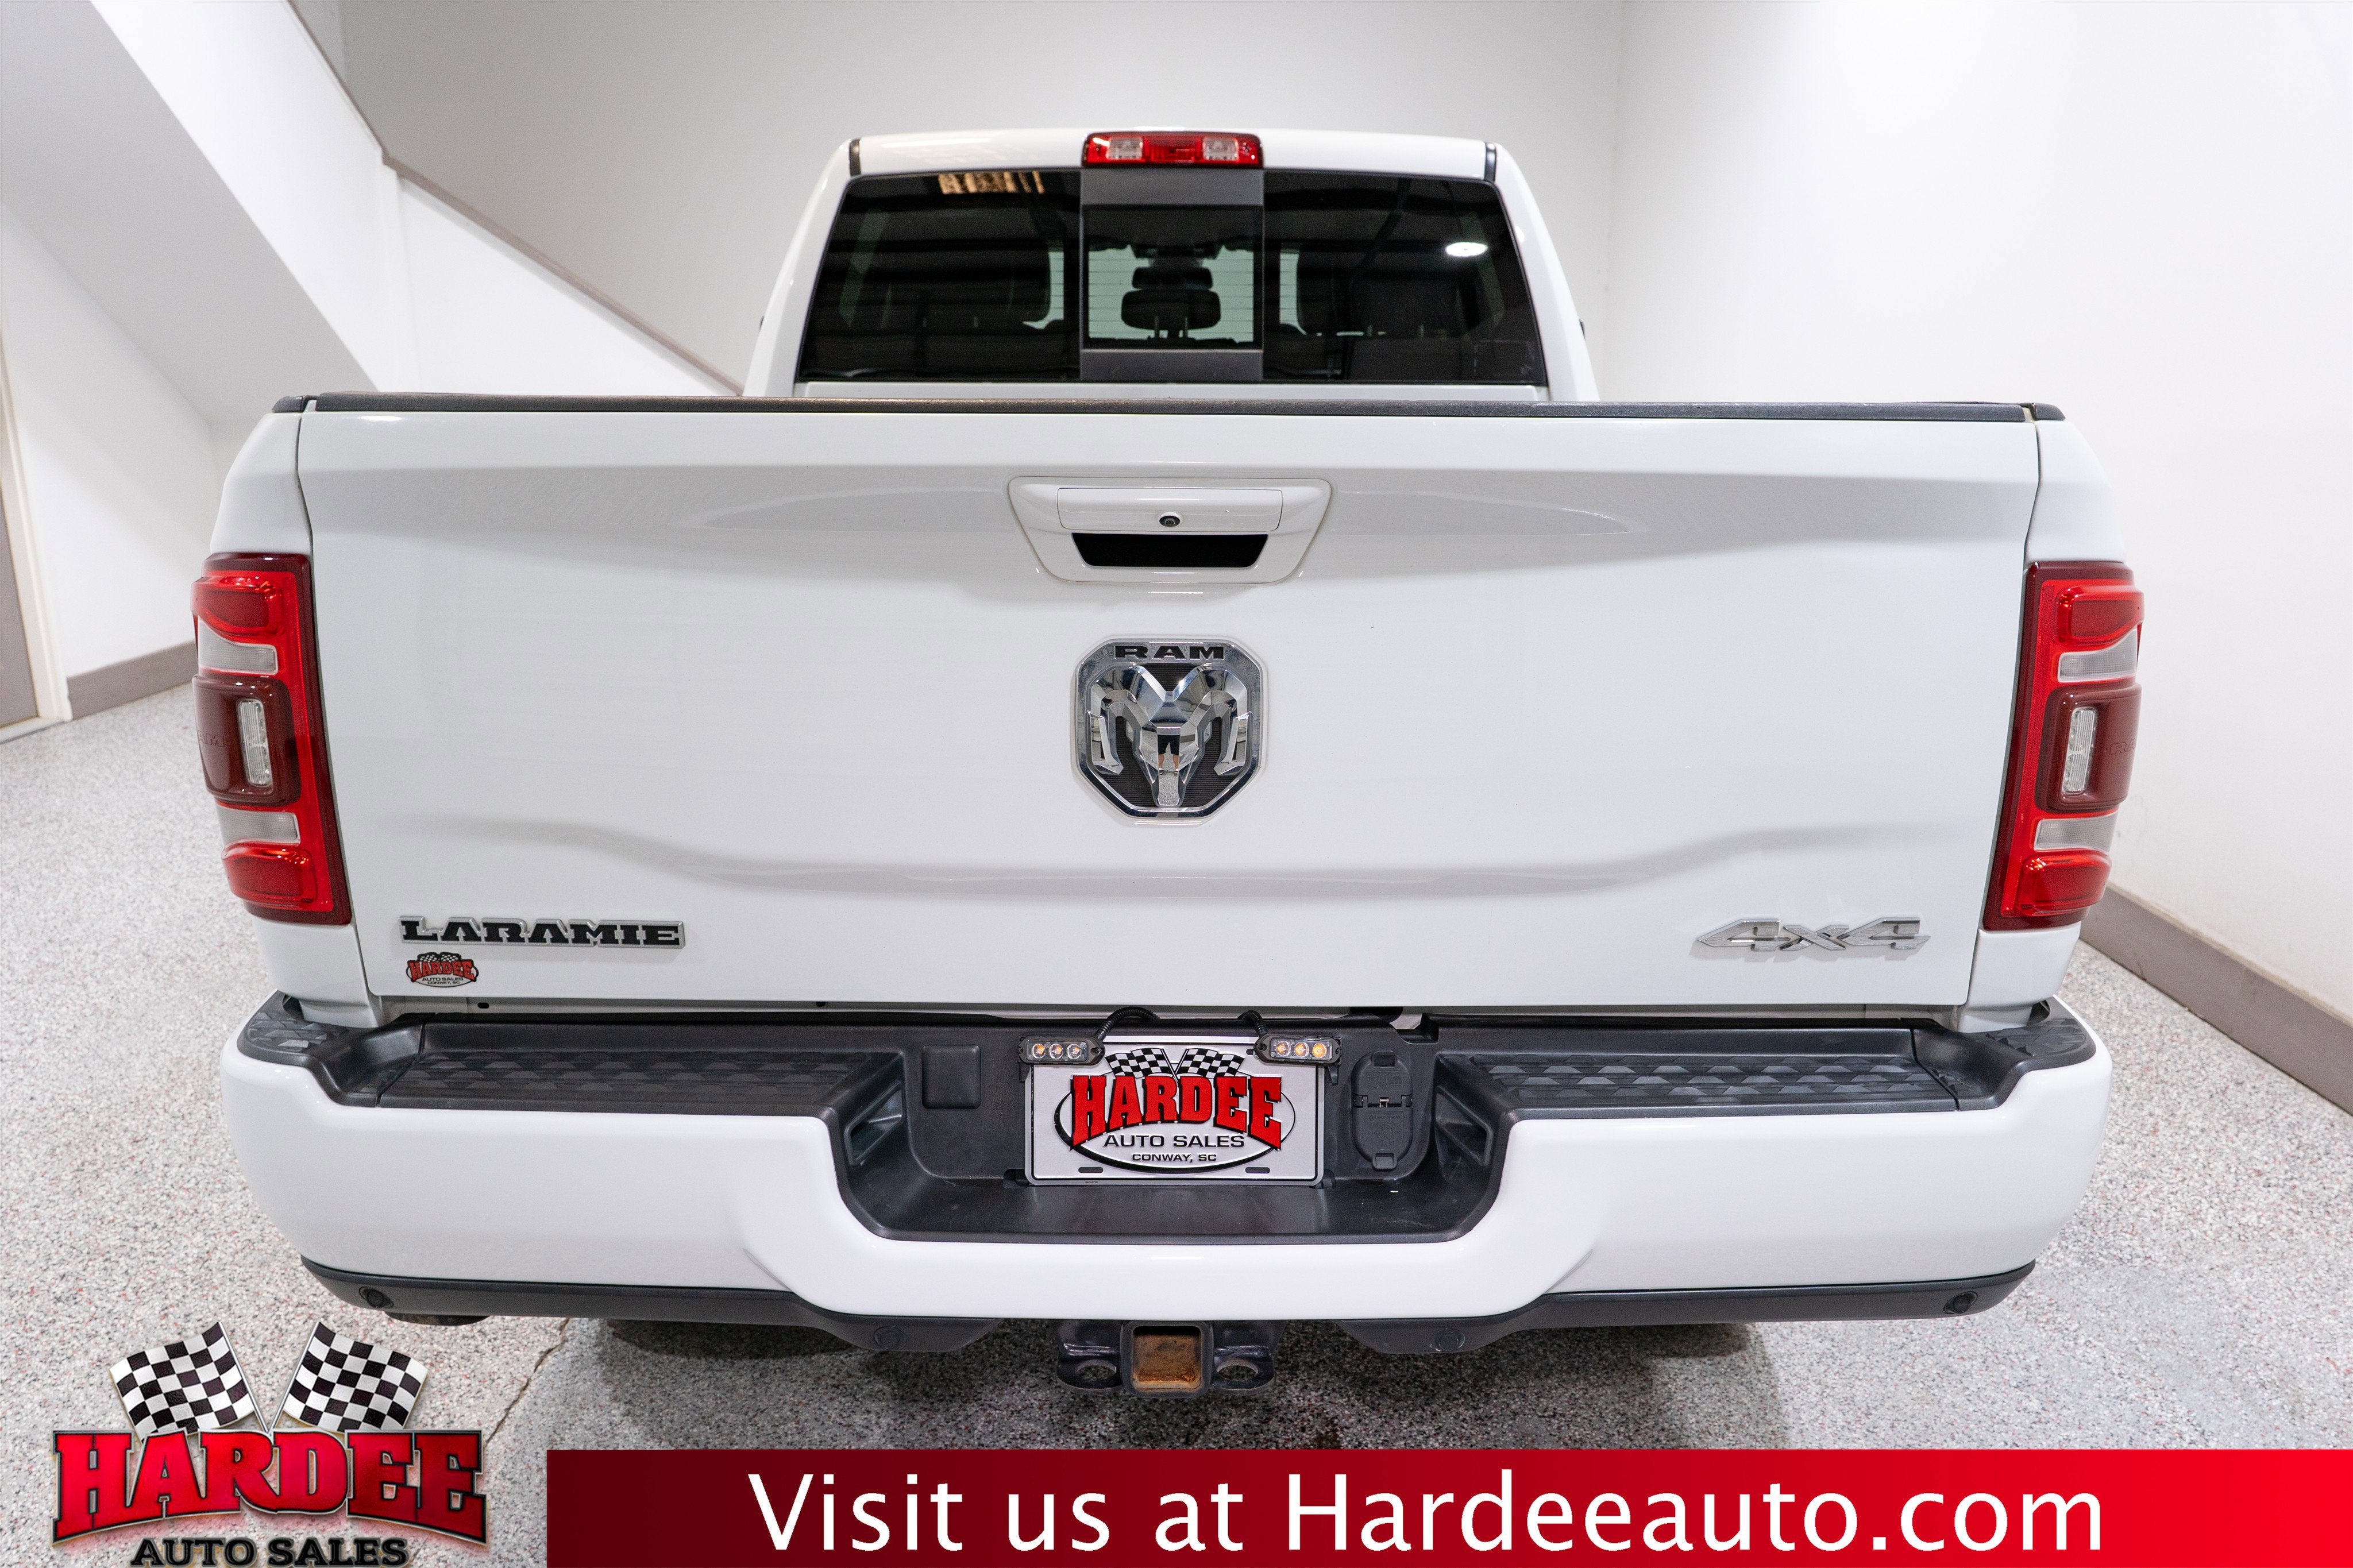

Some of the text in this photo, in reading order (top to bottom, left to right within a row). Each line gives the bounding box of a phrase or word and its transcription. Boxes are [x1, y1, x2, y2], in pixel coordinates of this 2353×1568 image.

[1114, 645, 1224, 660] RAM
[198, 729, 225, 748] AM
[399, 916, 685, 949] LARAMIE
[408, 960, 476, 982] HARDEE
[1070, 1076, 1282, 1150] HARDEE
[1104, 1134, 1245, 1148] AUTO SALES
[1132, 1154, 1193, 1163] CONWAY,
